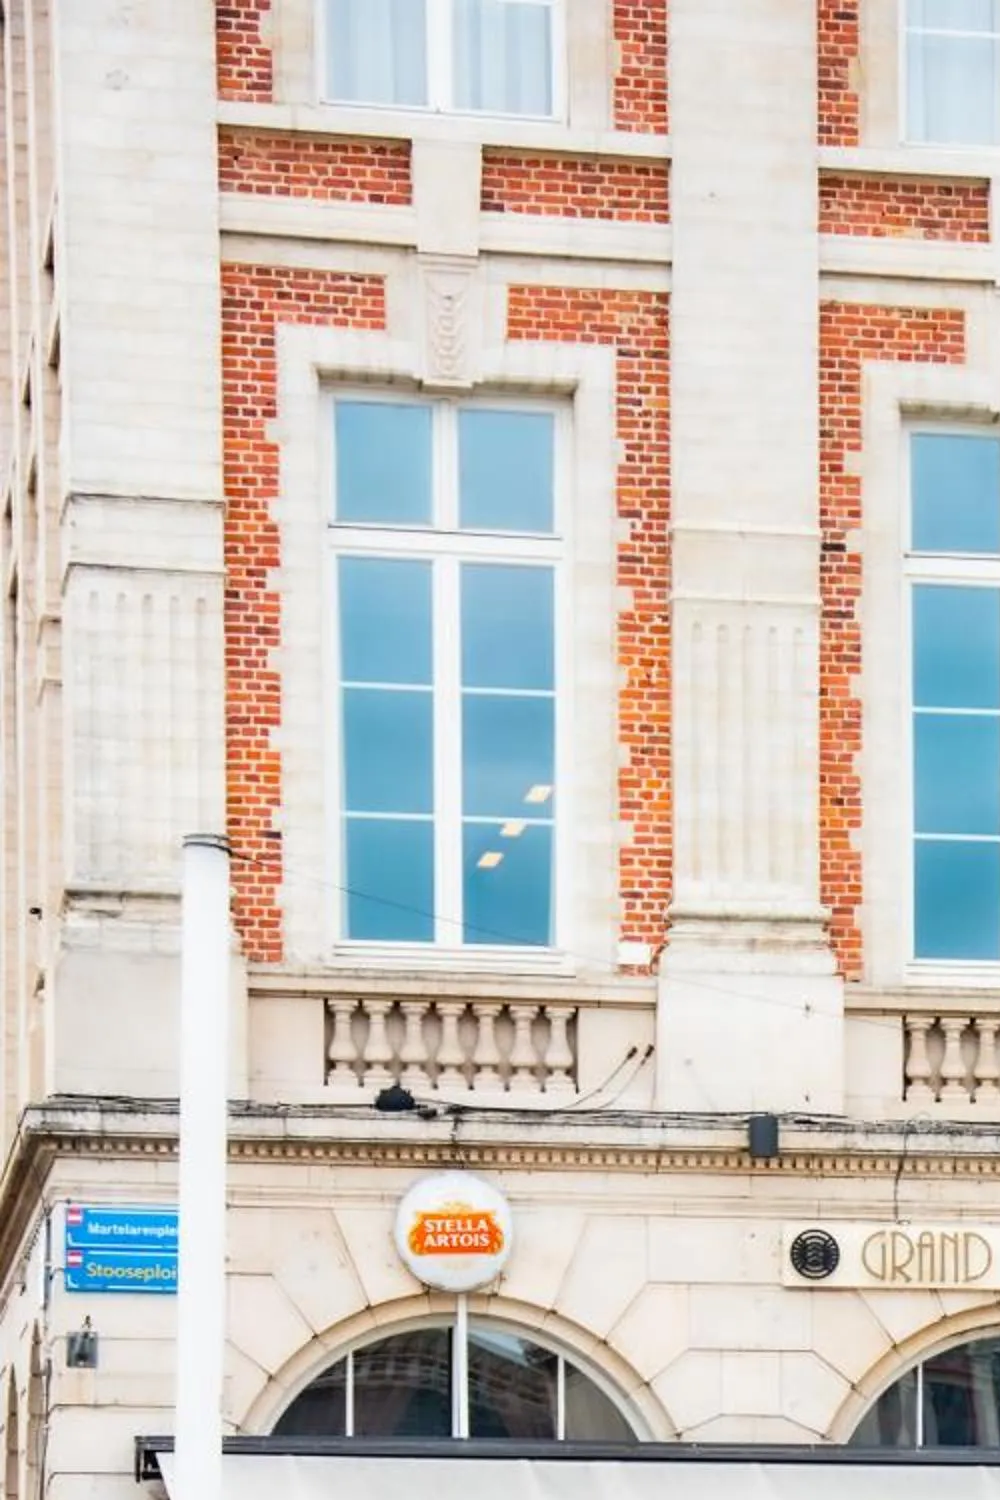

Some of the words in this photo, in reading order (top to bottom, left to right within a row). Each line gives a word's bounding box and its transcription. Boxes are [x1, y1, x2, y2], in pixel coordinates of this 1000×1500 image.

[424, 1219, 489, 1232] STELLA
[424, 1233, 490, 1247] ARTOIS
[861, 1230, 992, 1283] GRAND
